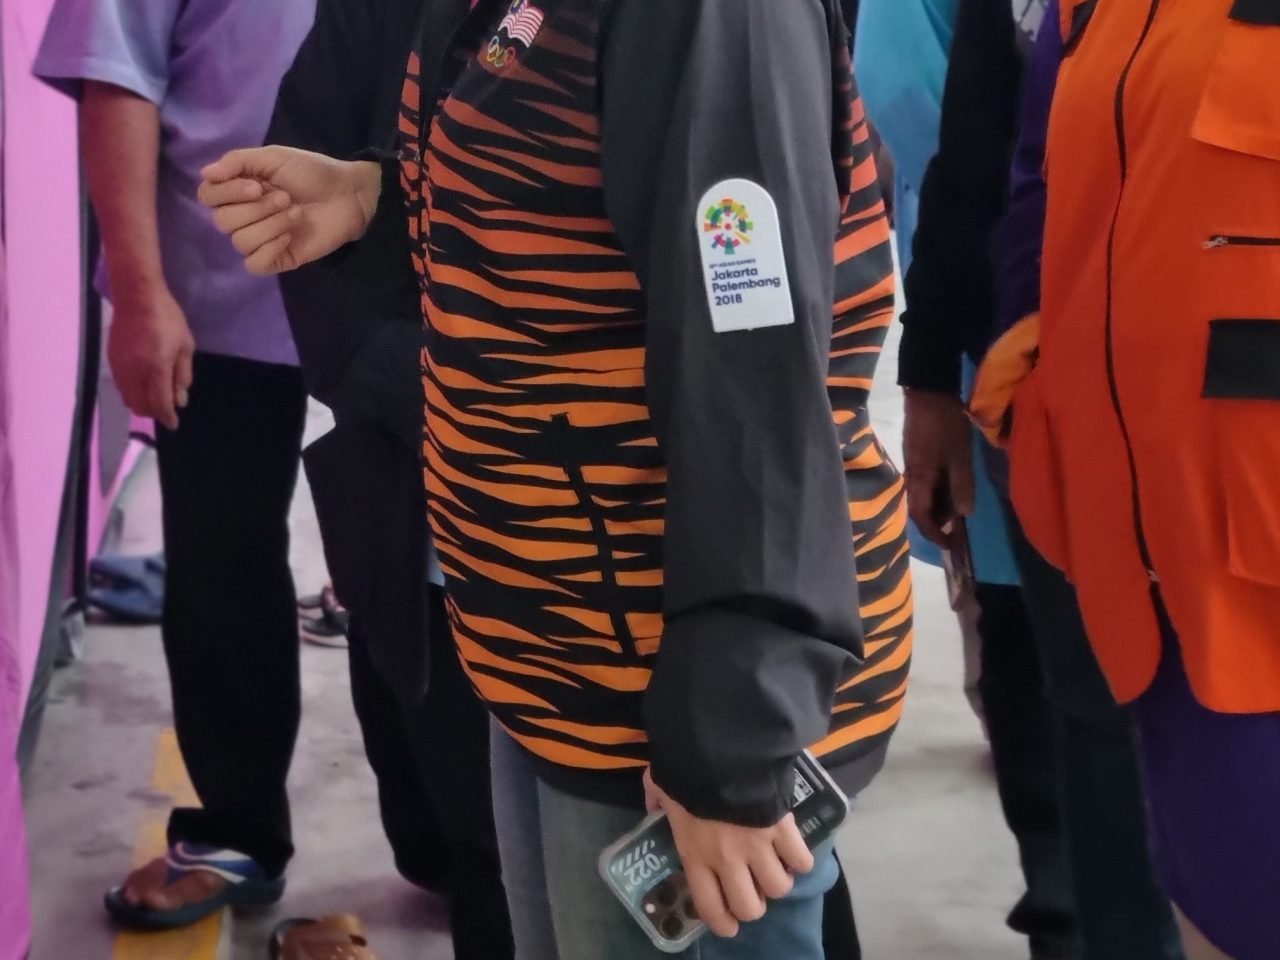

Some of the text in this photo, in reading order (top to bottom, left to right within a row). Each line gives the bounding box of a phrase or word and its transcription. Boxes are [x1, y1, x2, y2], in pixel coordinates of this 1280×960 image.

[712, 268, 758, 281] Jakarta
[712, 277, 781, 293] Palembang
[715, 293, 743, 306] 2018
